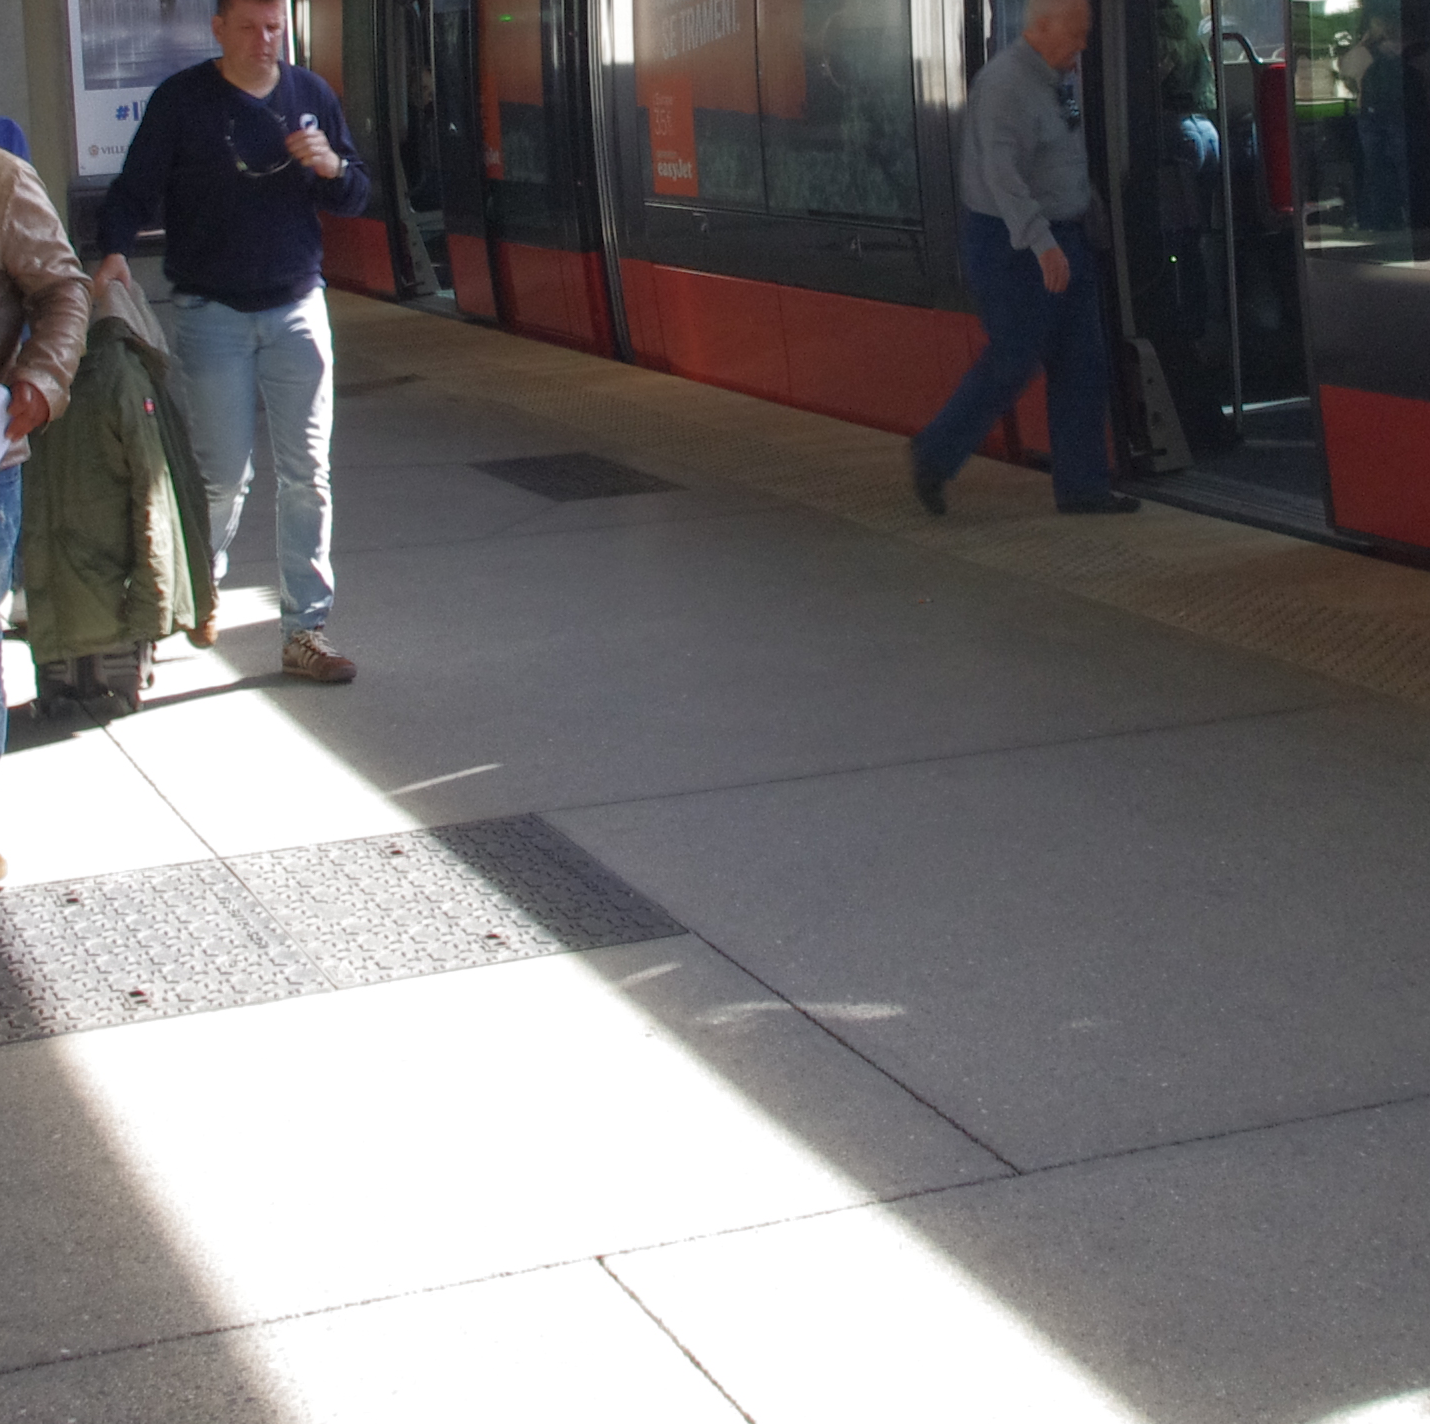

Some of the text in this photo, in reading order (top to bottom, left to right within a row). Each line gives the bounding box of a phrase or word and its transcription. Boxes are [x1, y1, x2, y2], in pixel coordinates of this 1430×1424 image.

[662, 15, 678, 60] SE
[100, 146, 125, 155] VILLE
[657, 158, 693, 182] easyJet
